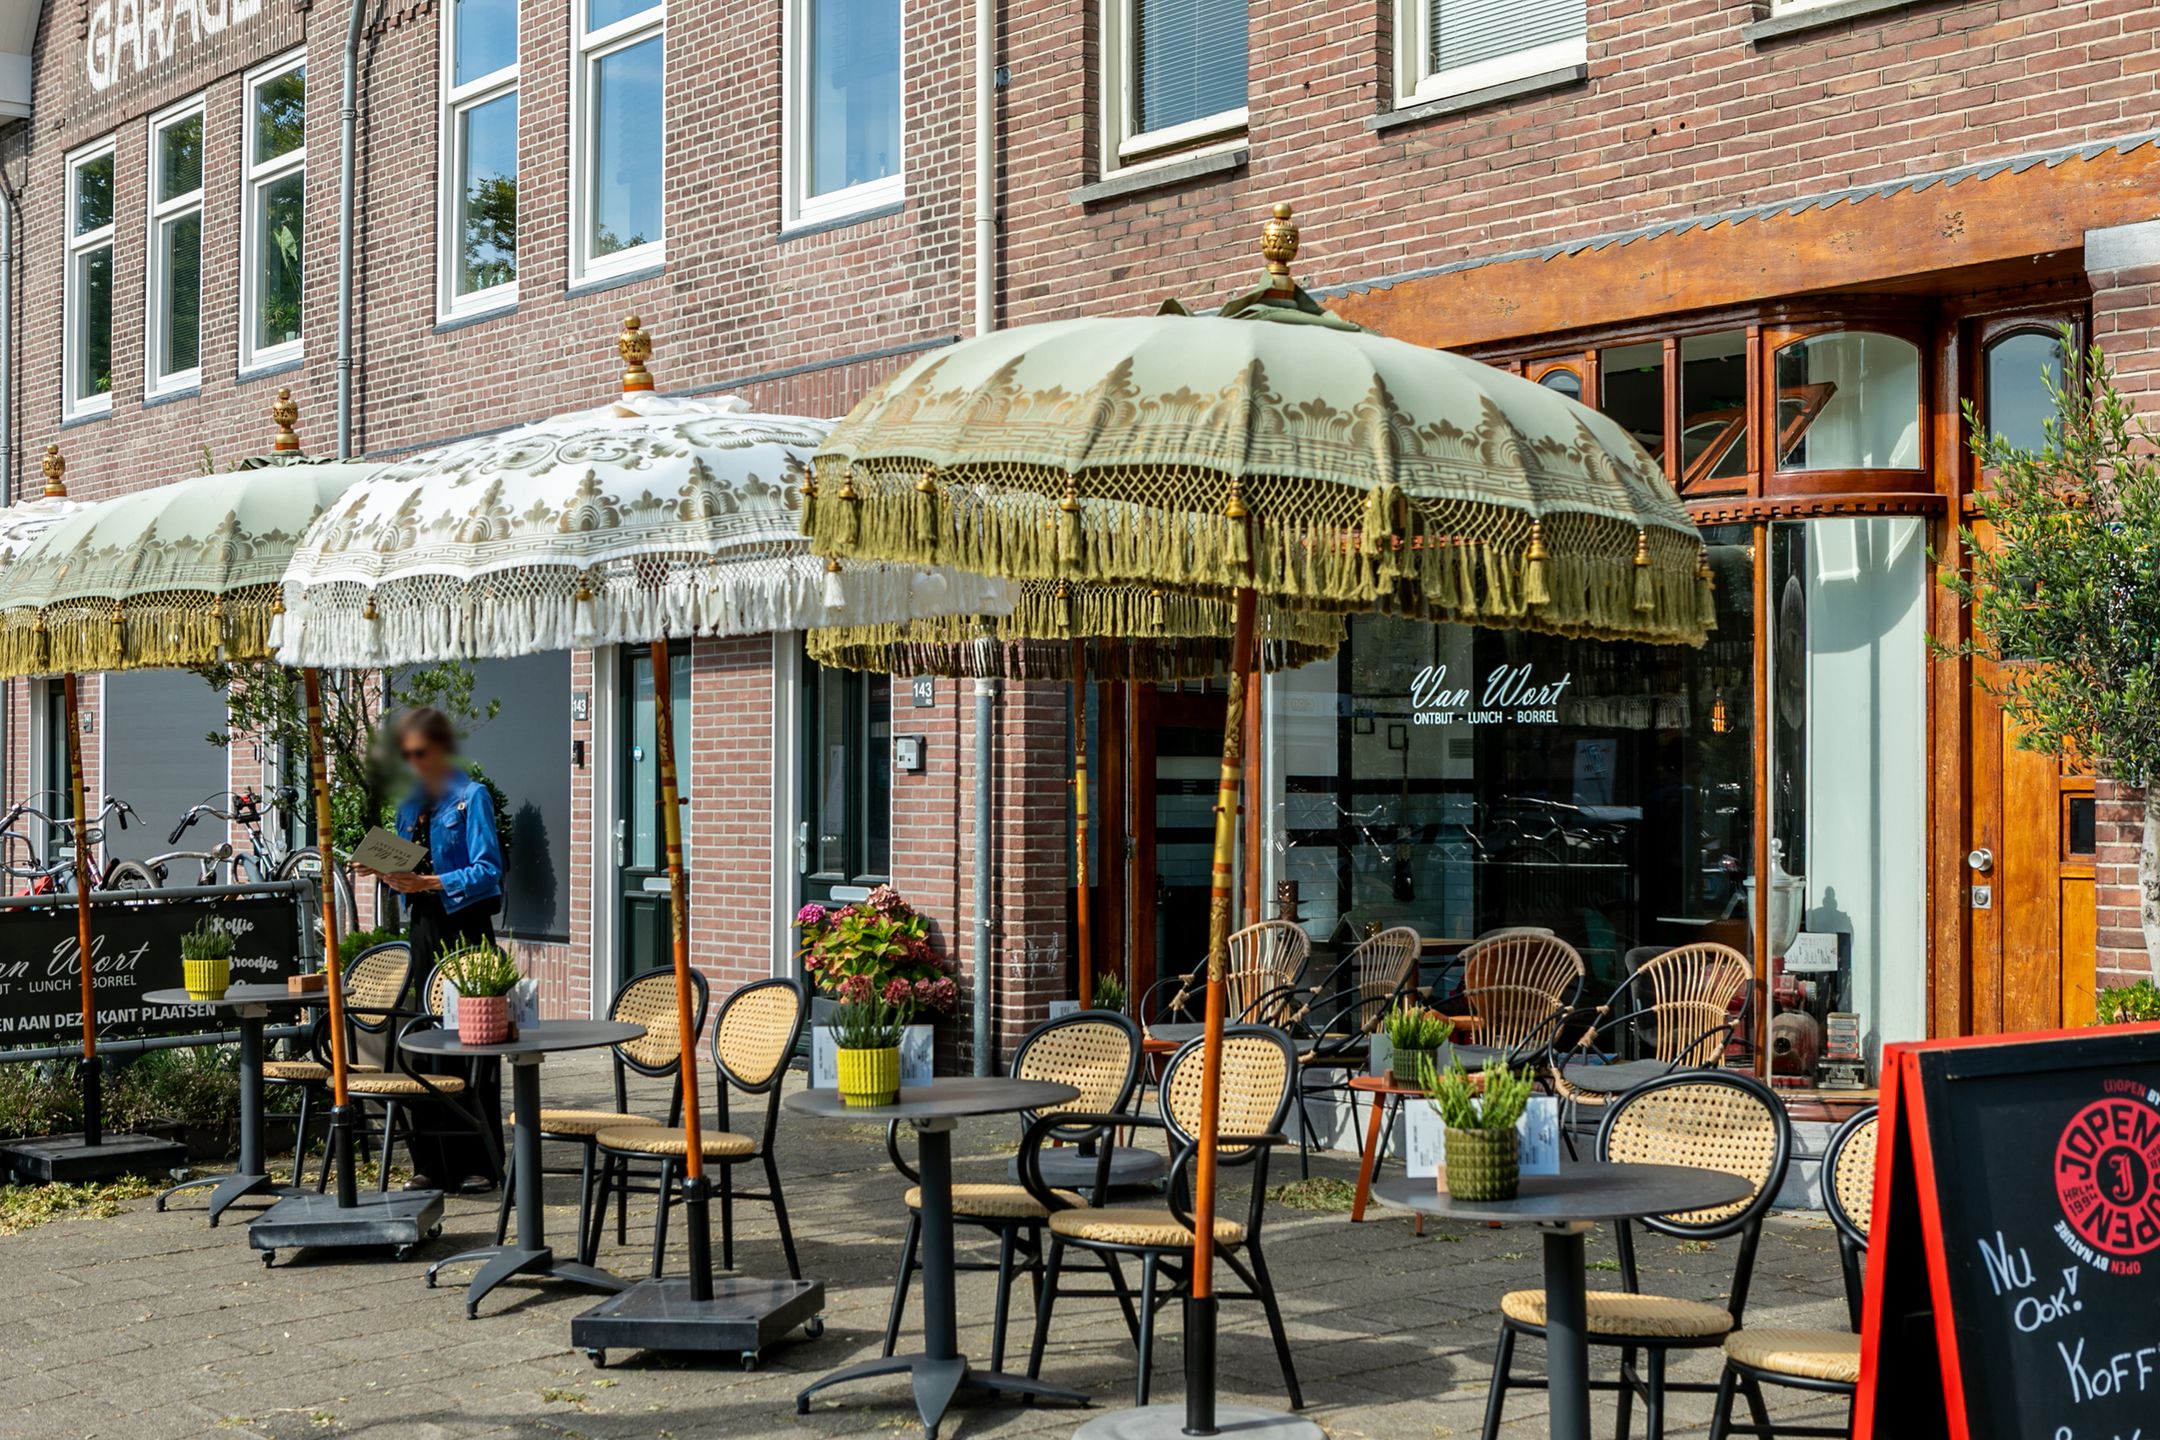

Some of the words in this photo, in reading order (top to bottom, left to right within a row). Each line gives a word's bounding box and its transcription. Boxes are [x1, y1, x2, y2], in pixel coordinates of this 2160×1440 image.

[87, 0, 262, 91] GARA
[913, 682, 932, 698] 143
[1410, 664, 1470, 708] Van
[1482, 662, 1571, 707] Wort
[573, 699, 586, 712] 143
[1413, 711, 1454, 725] ONTBIJT
[1467, 711, 1502, 724] LUNCH
[1517, 710, 1558, 723] BORREL
[210, 918, 254, 935] Koffie
[0, 960, 30, 979] an
[47, 934, 150, 977] Wort
[29, 979, 72, 993] LUNCH
[18, 1014, 51, 1031] AAN
[54, 1012, 84, 1029] DEZ
[97, 1008, 138, 1024] KANT
[142, 1003, 216, 1021] PLAATSEN
[2060, 1104, 2160, 1180] JOPEN
[2062, 1184, 2095, 1202] HRLM
[2068, 1193, 2099, 1217] 1994
[2053, 1219, 2094, 1264] NATURE
[2092, 1254, 2110, 1272] BY
[2111, 1260, 2141, 1275] OPEN
[2057, 1337, 2160, 1403] KOFF
